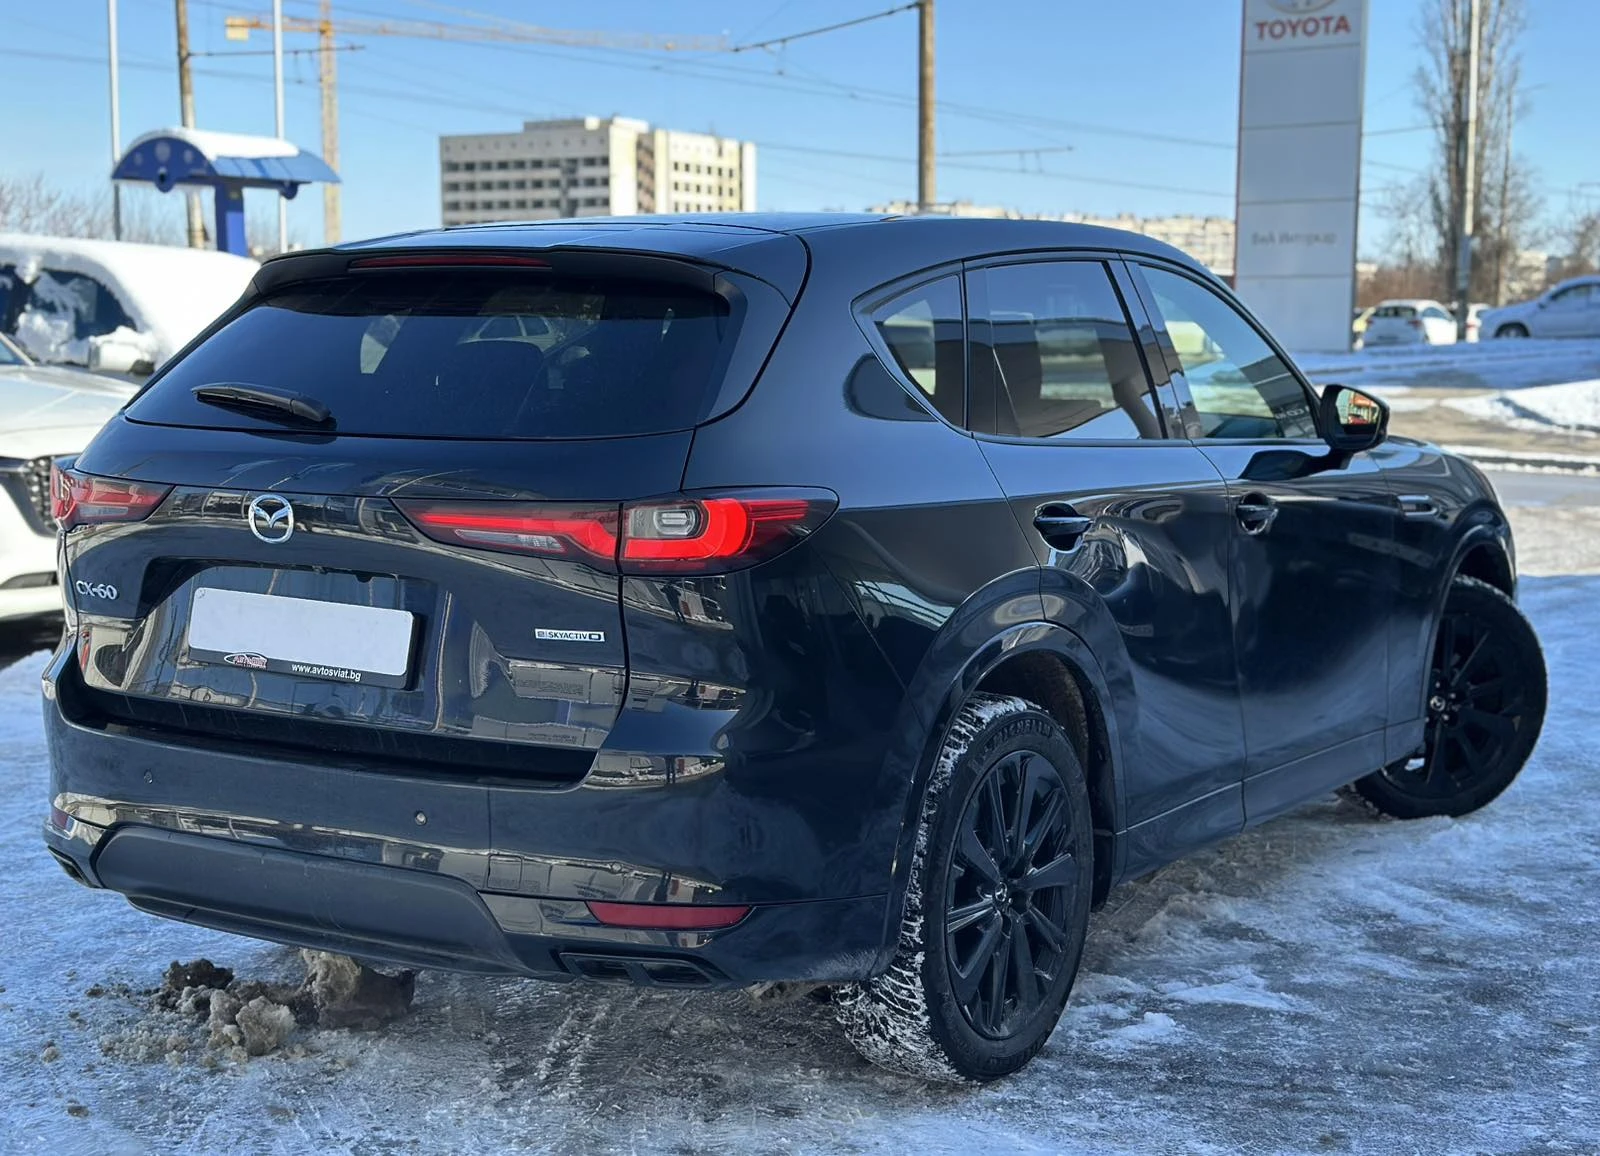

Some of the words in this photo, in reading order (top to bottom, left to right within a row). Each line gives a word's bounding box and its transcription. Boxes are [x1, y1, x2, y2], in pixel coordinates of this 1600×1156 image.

[1255, 15, 1351, 41] TOYOTA
[76, 580, 118, 600] CX-60
[548, 631, 588, 640] SKYACTIV
[291, 664, 361, 682] www.avtosviat.bg
